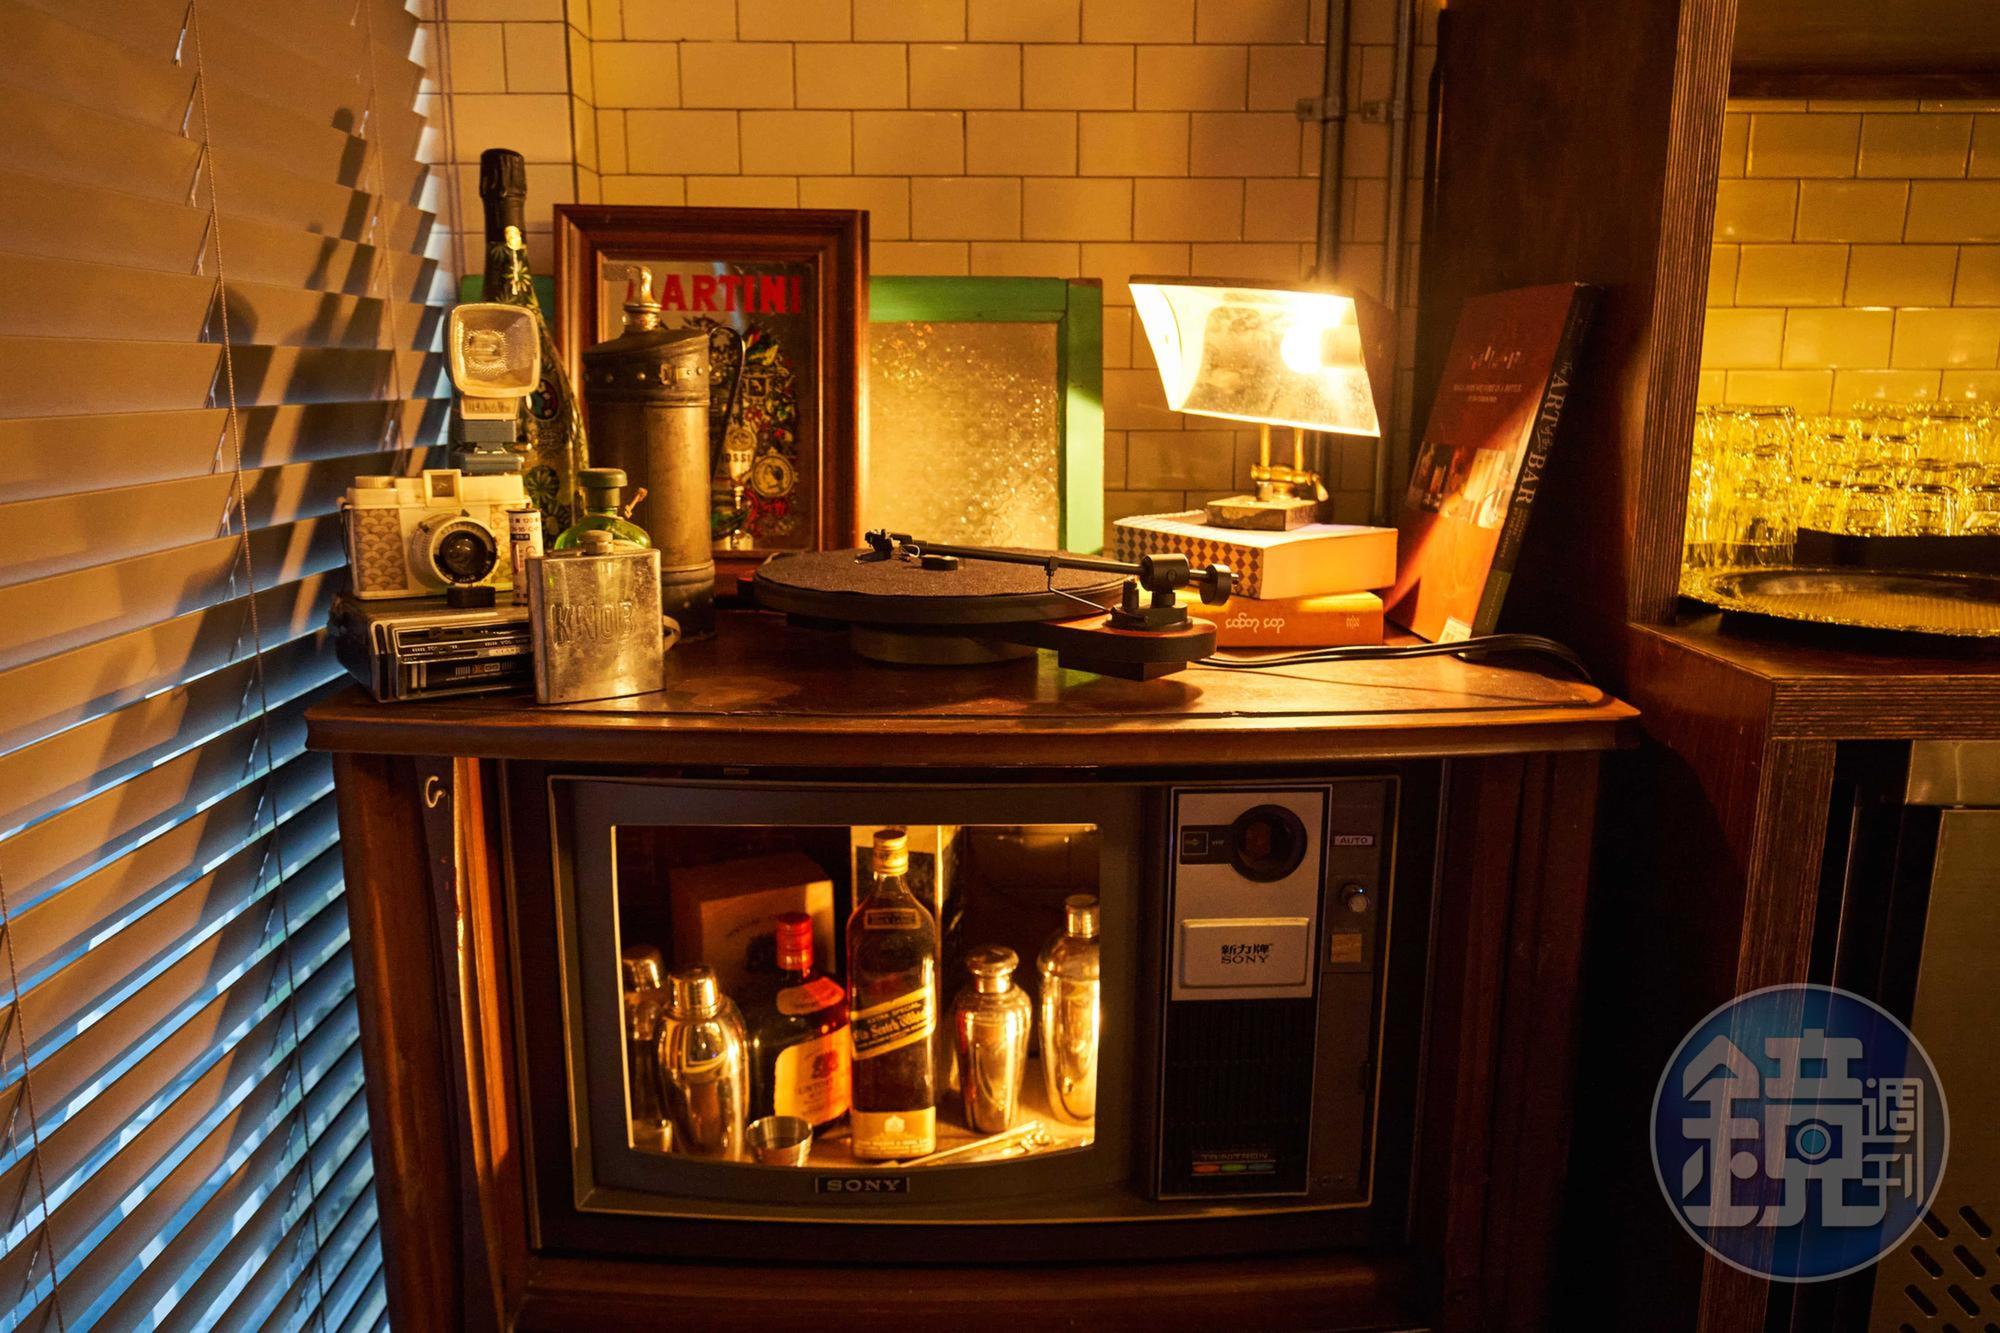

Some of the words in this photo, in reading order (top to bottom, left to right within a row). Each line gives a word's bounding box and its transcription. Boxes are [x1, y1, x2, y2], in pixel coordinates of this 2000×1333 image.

[626, 274, 801, 314] ARTINI
[1541, 372, 1571, 429] ART
[1514, 451, 1548, 506] BAR
[549, 601, 637, 648] KNOB
[1339, 836, 1369, 846] AUTO
[1221, 943, 1270, 955] 新力牌
[1221, 955, 1270, 965] SONY
[826, 1179, 901, 1192] SONY
